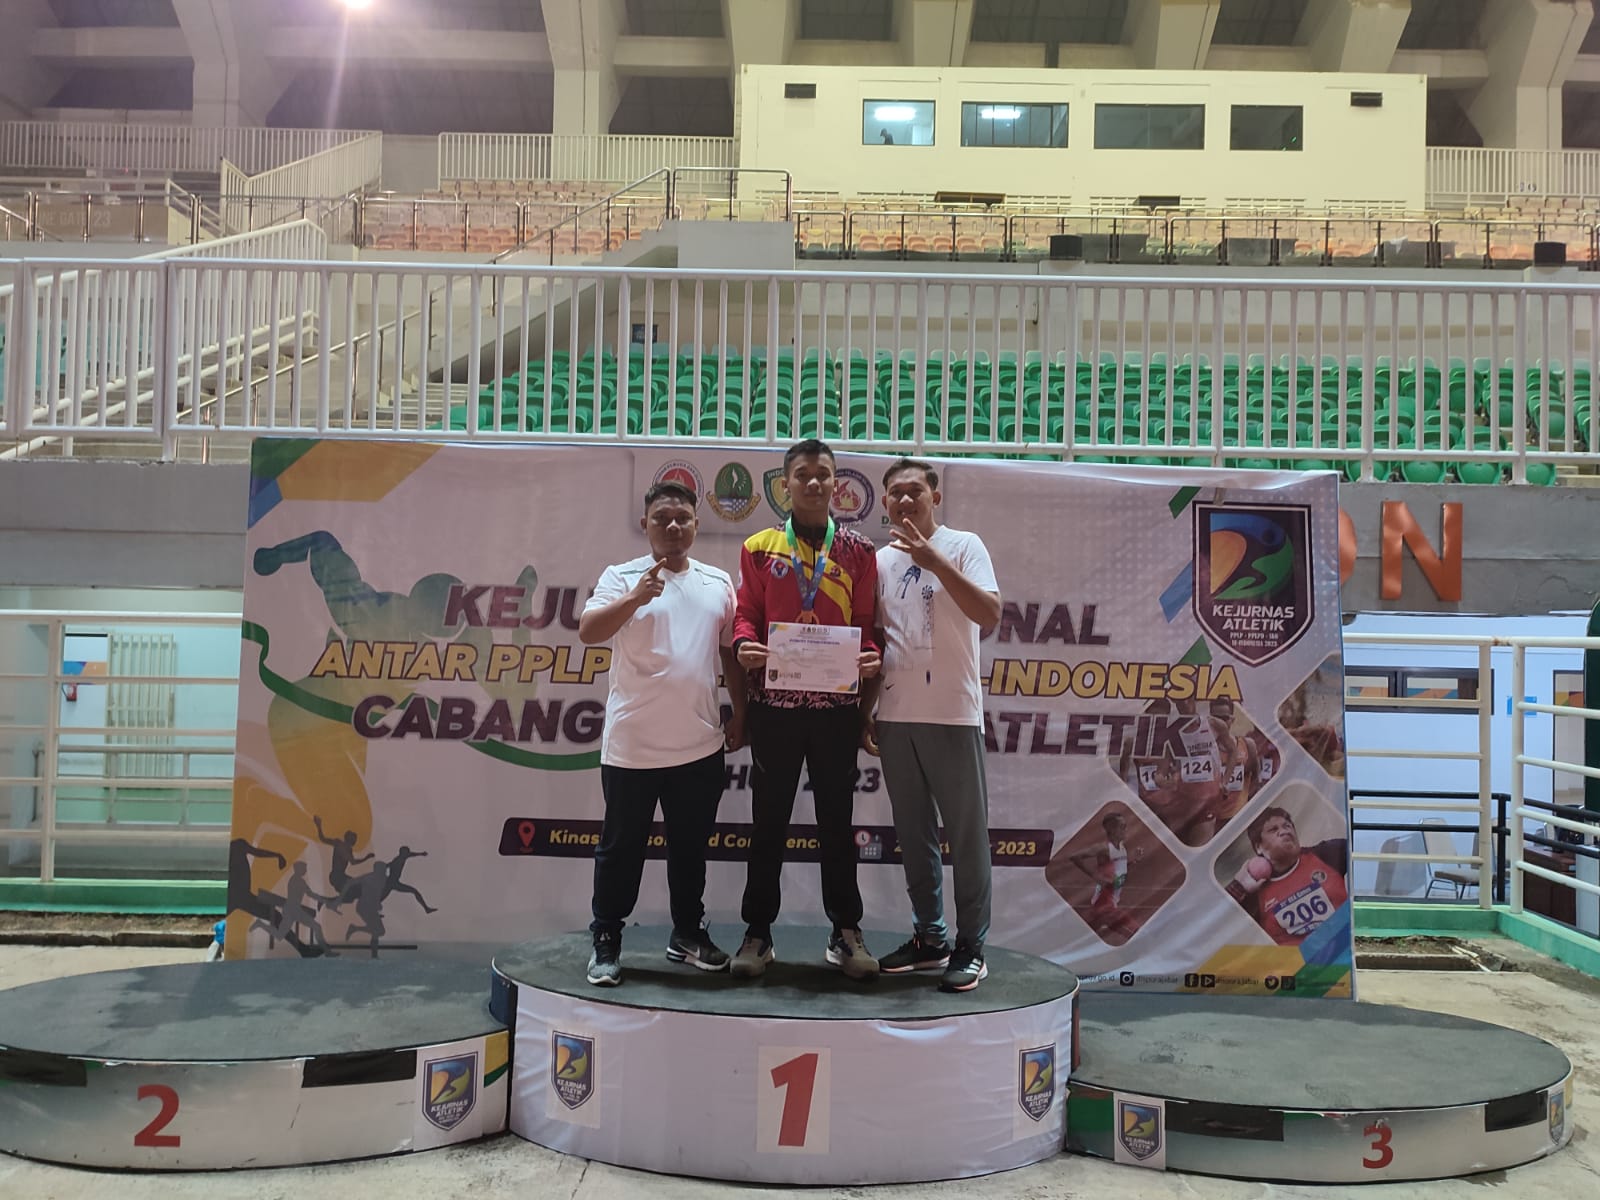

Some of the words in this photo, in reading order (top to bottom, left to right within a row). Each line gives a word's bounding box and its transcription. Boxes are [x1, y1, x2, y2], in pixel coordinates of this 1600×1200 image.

[980, 603, 1110, 645] NAL
[1213, 605, 1295, 618] KEJURNAS
[1222, 618, 1285, 631] ATLETIK
[309, 640, 478, 681] ANTAR
[353, 695, 604, 743] CABANG
[1183, 759, 1212, 775] 124
[995, 841, 1036, 855] 2023
[1282, 895, 1328, 928] 206
[133, 1084, 181, 1148] 2
[770, 1052, 819, 1147] 1
[1361, 1124, 1395, 1169] 3
